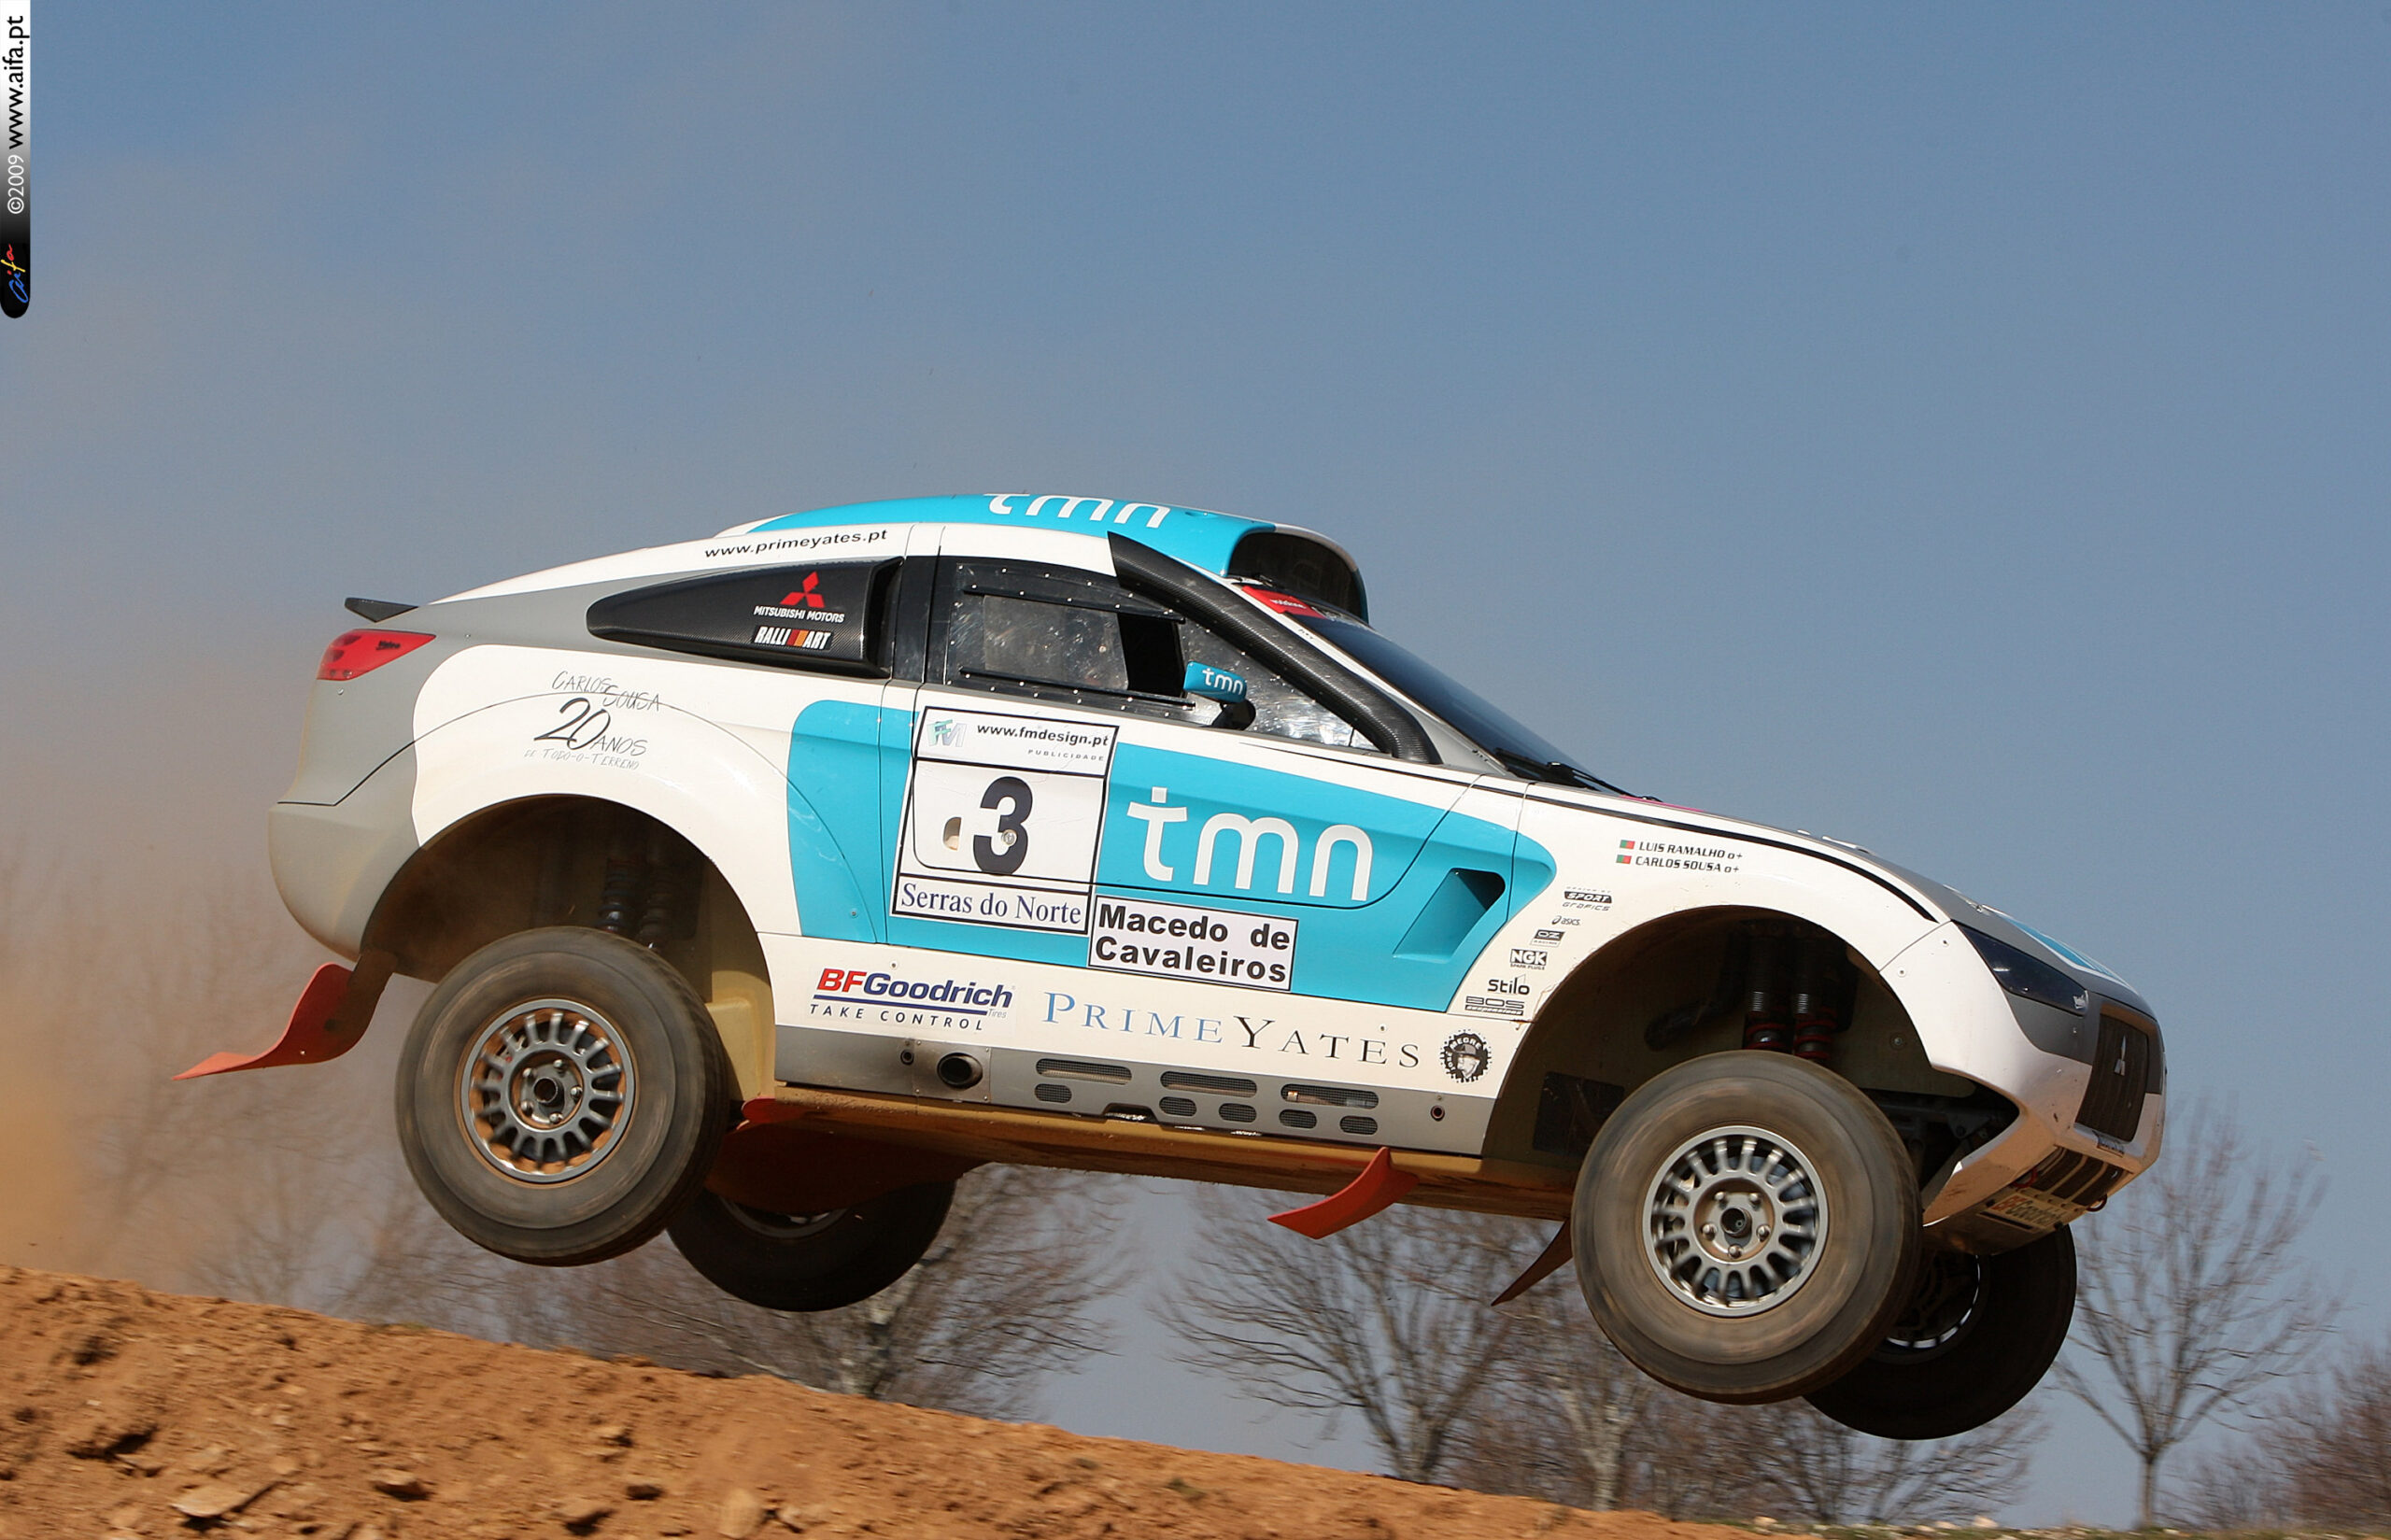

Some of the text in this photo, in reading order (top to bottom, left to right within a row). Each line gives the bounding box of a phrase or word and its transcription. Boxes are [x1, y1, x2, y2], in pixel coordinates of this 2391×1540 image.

[705, 530, 888, 558] www.primeyates.pt
[754, 605, 845, 624] MITSUBISHI MOTORS
[552, 671, 660, 712] CARLOS SOUSA
[1202, 667, 1244, 696] tmn
[533, 697, 648, 756] 20 ANOS
[977, 724, 1110, 748] www.fmdesign.pt
[1027, 748, 1105, 762] PUBLICIDADE
[972, 776, 1034, 877] 3
[1126, 786, 1374, 901] tmn
[1638, 841, 1665, 853] LUIS
[1666, 843, 1726, 858] RAMALHO
[1635, 855, 1681, 869] CARLOS
[1683, 860, 1721, 872] SOUSA
[901, 883, 1082, 925] Serras do Norte
[1566, 892, 1610, 903] SPORT
[1099, 903, 1291, 951] Macedo de
[1097, 936, 1287, 983] Cavaleiros
[1510, 949, 1548, 967] NGK
[817, 968, 1013, 1009] BFGoodrich
[1487, 977, 1530, 996] Stilo
[810, 1004, 983, 1031] TAKE CONTROL
